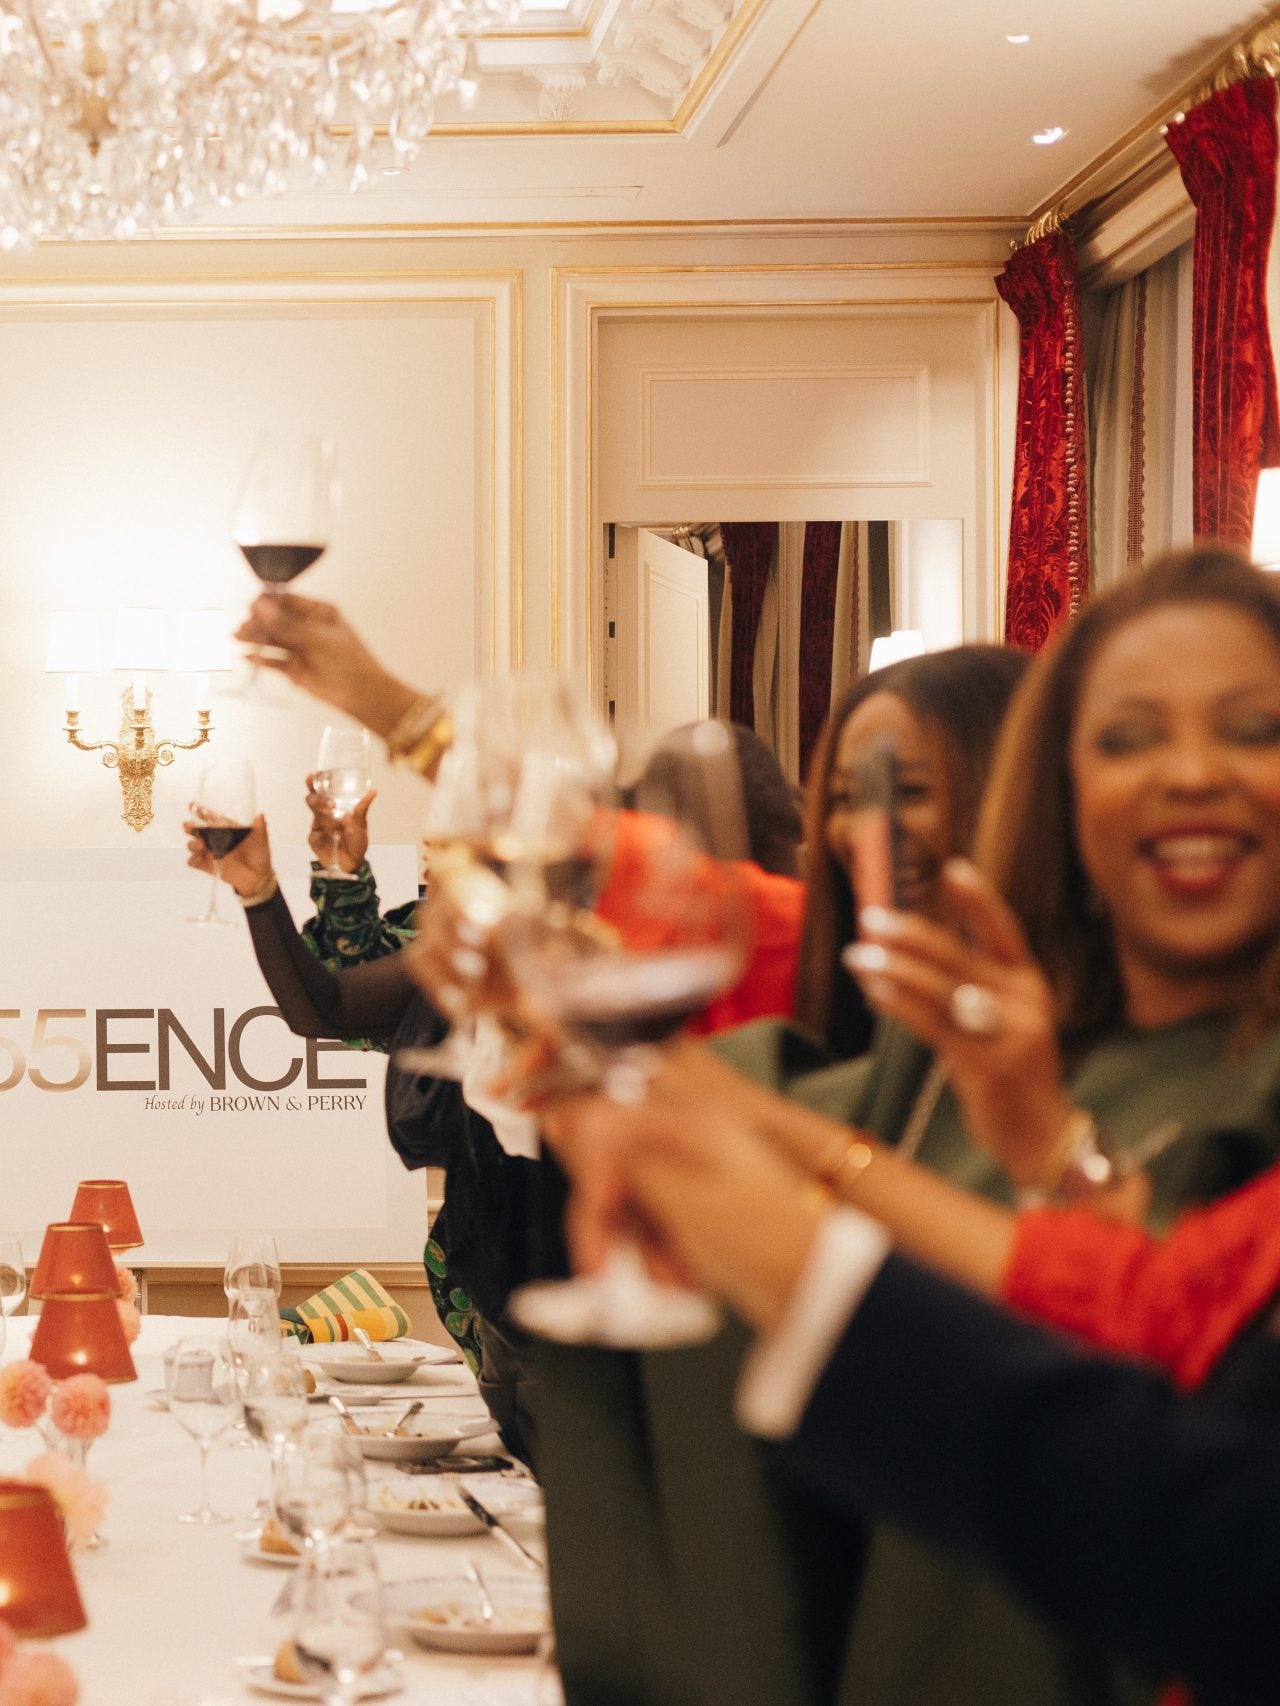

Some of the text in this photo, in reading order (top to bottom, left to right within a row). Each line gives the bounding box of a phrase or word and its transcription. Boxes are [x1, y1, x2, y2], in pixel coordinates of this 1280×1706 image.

[144, 1095, 367, 1116] Hosted by BROWN & PERRY
